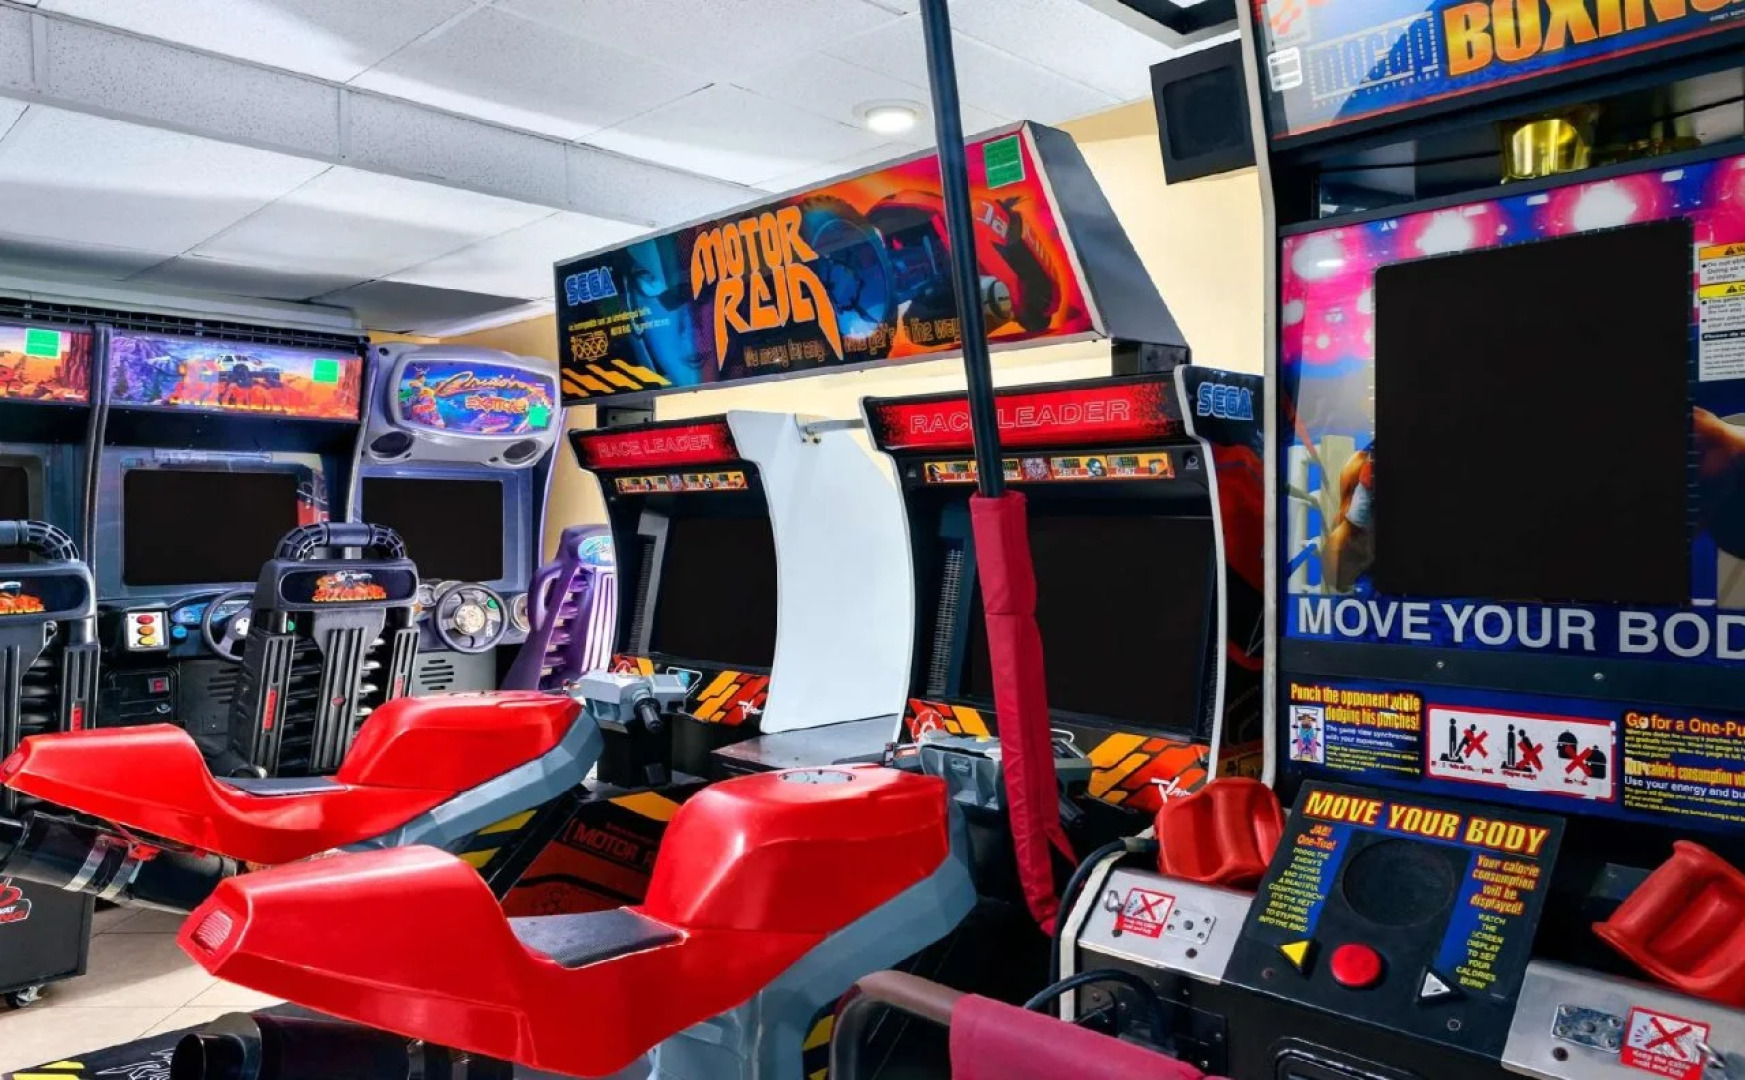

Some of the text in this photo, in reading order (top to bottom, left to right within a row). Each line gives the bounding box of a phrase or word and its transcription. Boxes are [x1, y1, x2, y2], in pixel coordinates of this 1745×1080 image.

[1443, 0, 1730, 76] BOXI
[691, 206, 819, 300] MOTOR
[564, 265, 618, 306] SEGA
[910, 399, 1130, 434] RAC LEADER
[1197, 382, 1253, 420] SEGA
[597, 434, 714, 459] RACE LEADER
[1299, 598, 1431, 641] MOVE
[1441, 603, 1596, 651] YOUR
[1291, 682, 1321, 702] Punch
[1323, 687, 1339, 704] the
[1341, 690, 1389, 709] opponent
[1626, 713, 1649, 729] Go
[1651, 714, 1671, 730] for
[1676, 720, 1685, 731] a
[1625, 776, 1643, 787] Use
[1646, 780, 1669, 791] your
[1671, 783, 1707, 796] energy
[1709, 787, 1730, 797] and
[1305, 790, 1548, 854] MOVE YOUR BODY
[574, 822, 638, 861] MOTOR
[1477, 854, 1501, 869] Your
